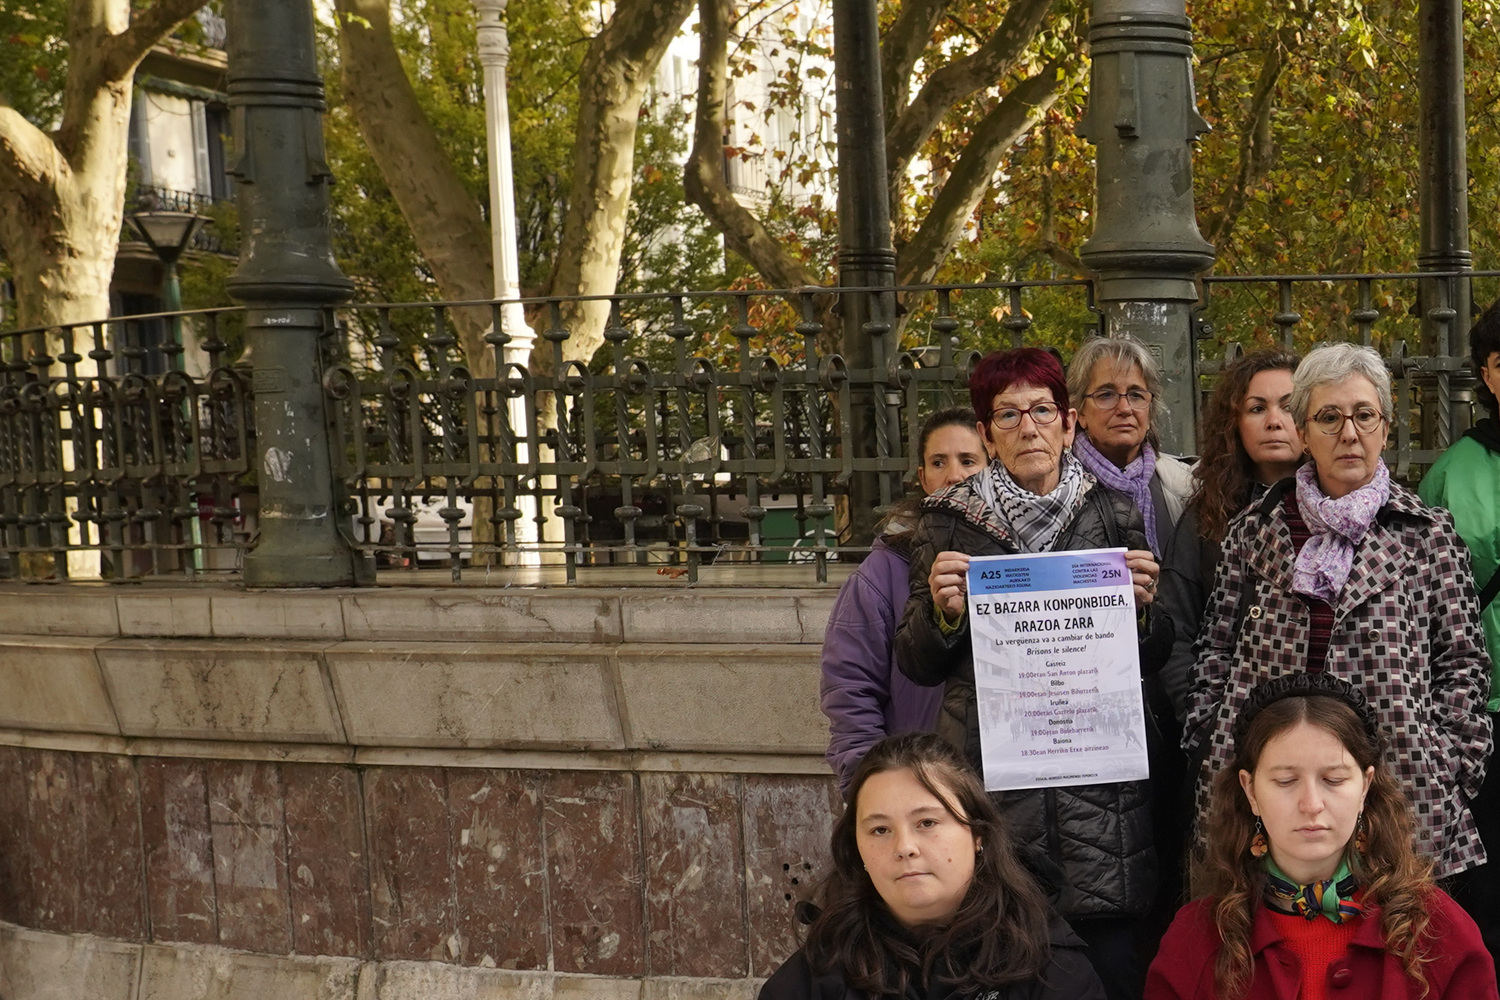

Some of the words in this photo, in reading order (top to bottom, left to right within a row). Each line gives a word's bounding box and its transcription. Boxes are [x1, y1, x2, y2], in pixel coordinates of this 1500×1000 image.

[981, 570, 1001, 580] A25
[1102, 569, 1121, 579] 25N
[976, 604, 990, 615] EZ
[994, 600, 1040, 614] BAZARA
[1044, 595, 1128, 610] KONPONBIDEA,
[1015, 619, 1061, 633] ARAZOA
[1064, 617, 1094, 630] ZARA
[1006, 636, 1040, 646] vergüenza
[1057, 634, 1083, 642] cambiar
[1062, 645, 1087, 653] silence!
